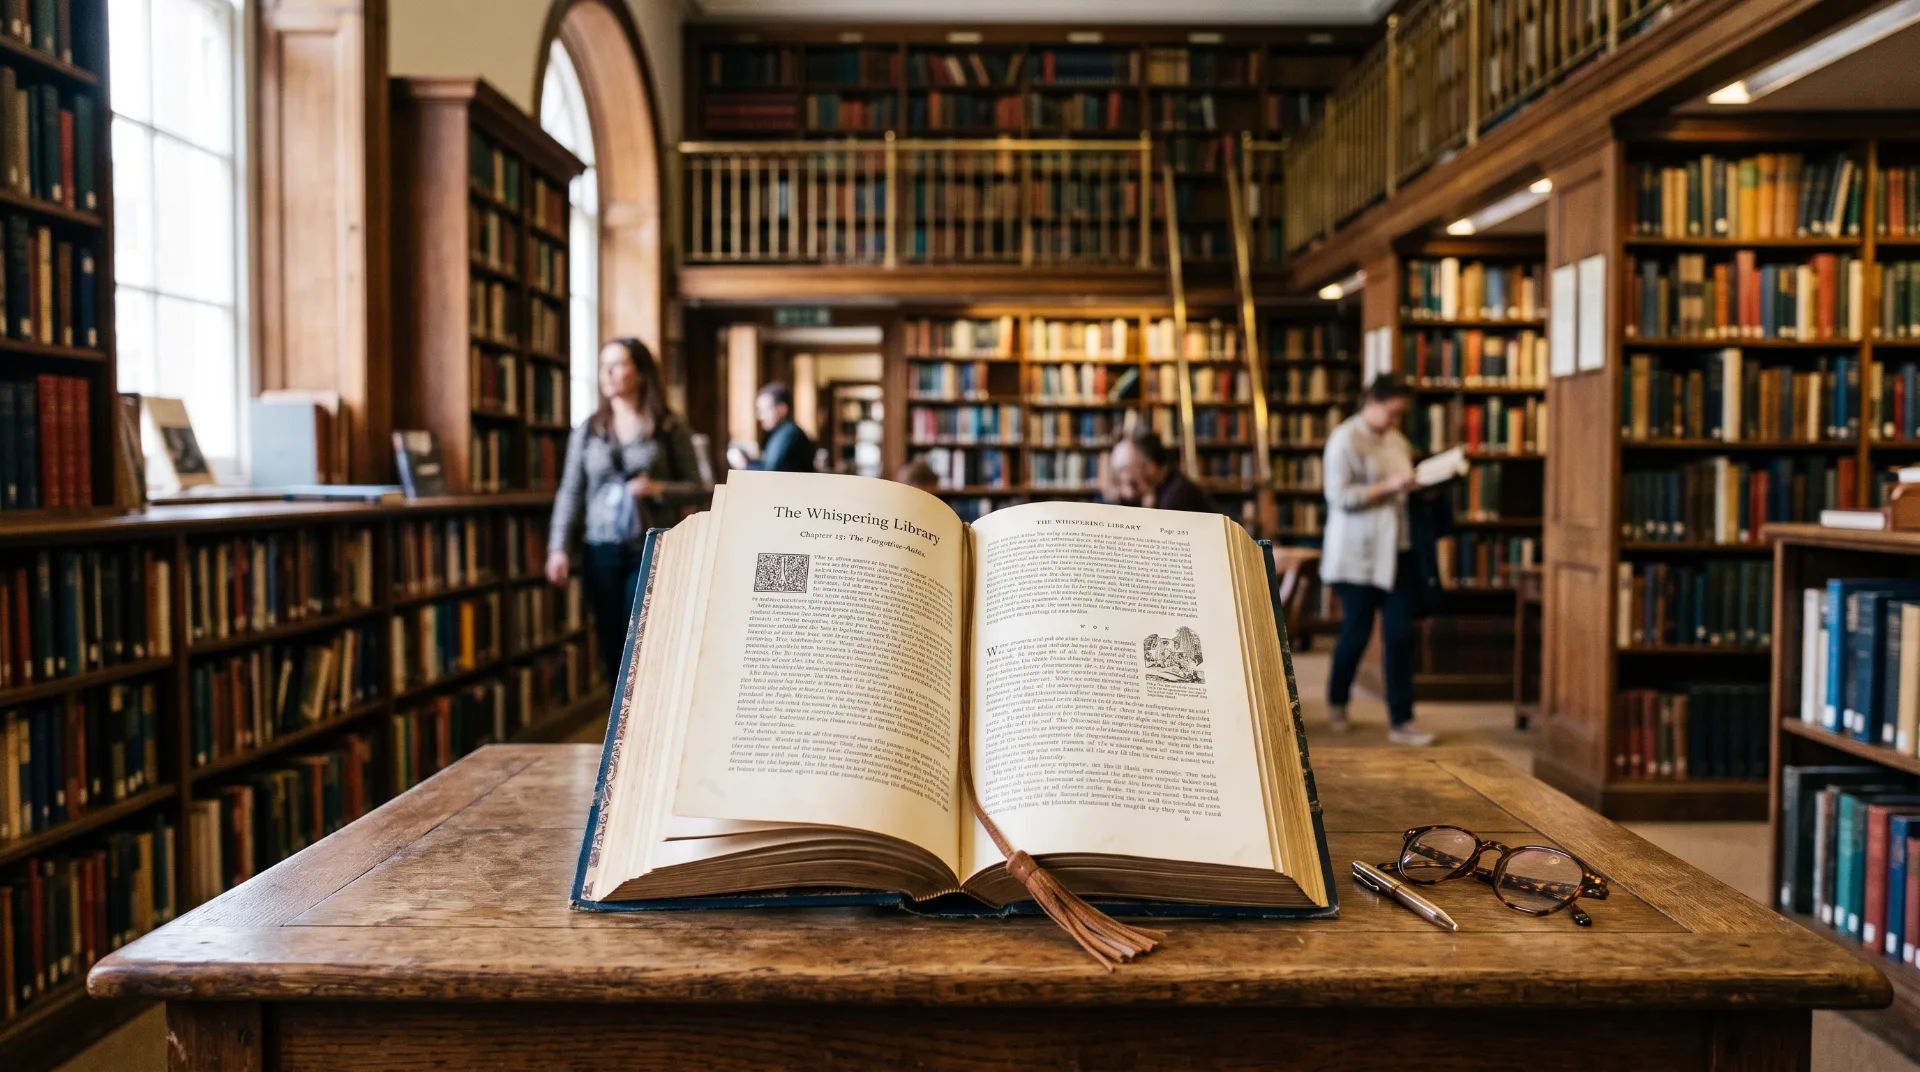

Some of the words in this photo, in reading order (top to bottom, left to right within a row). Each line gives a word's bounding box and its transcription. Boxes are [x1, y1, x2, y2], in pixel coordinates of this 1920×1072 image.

[774, 506, 802, 519] The
[806, 507, 889, 530] Whispering
[894, 517, 941, 546] Library
[1055, 519, 1105, 527] WHISPERING
[1107, 522, 1141, 531] LIBRARY
[1159, 527, 1175, 535] Page
[849, 534, 864, 542] The
